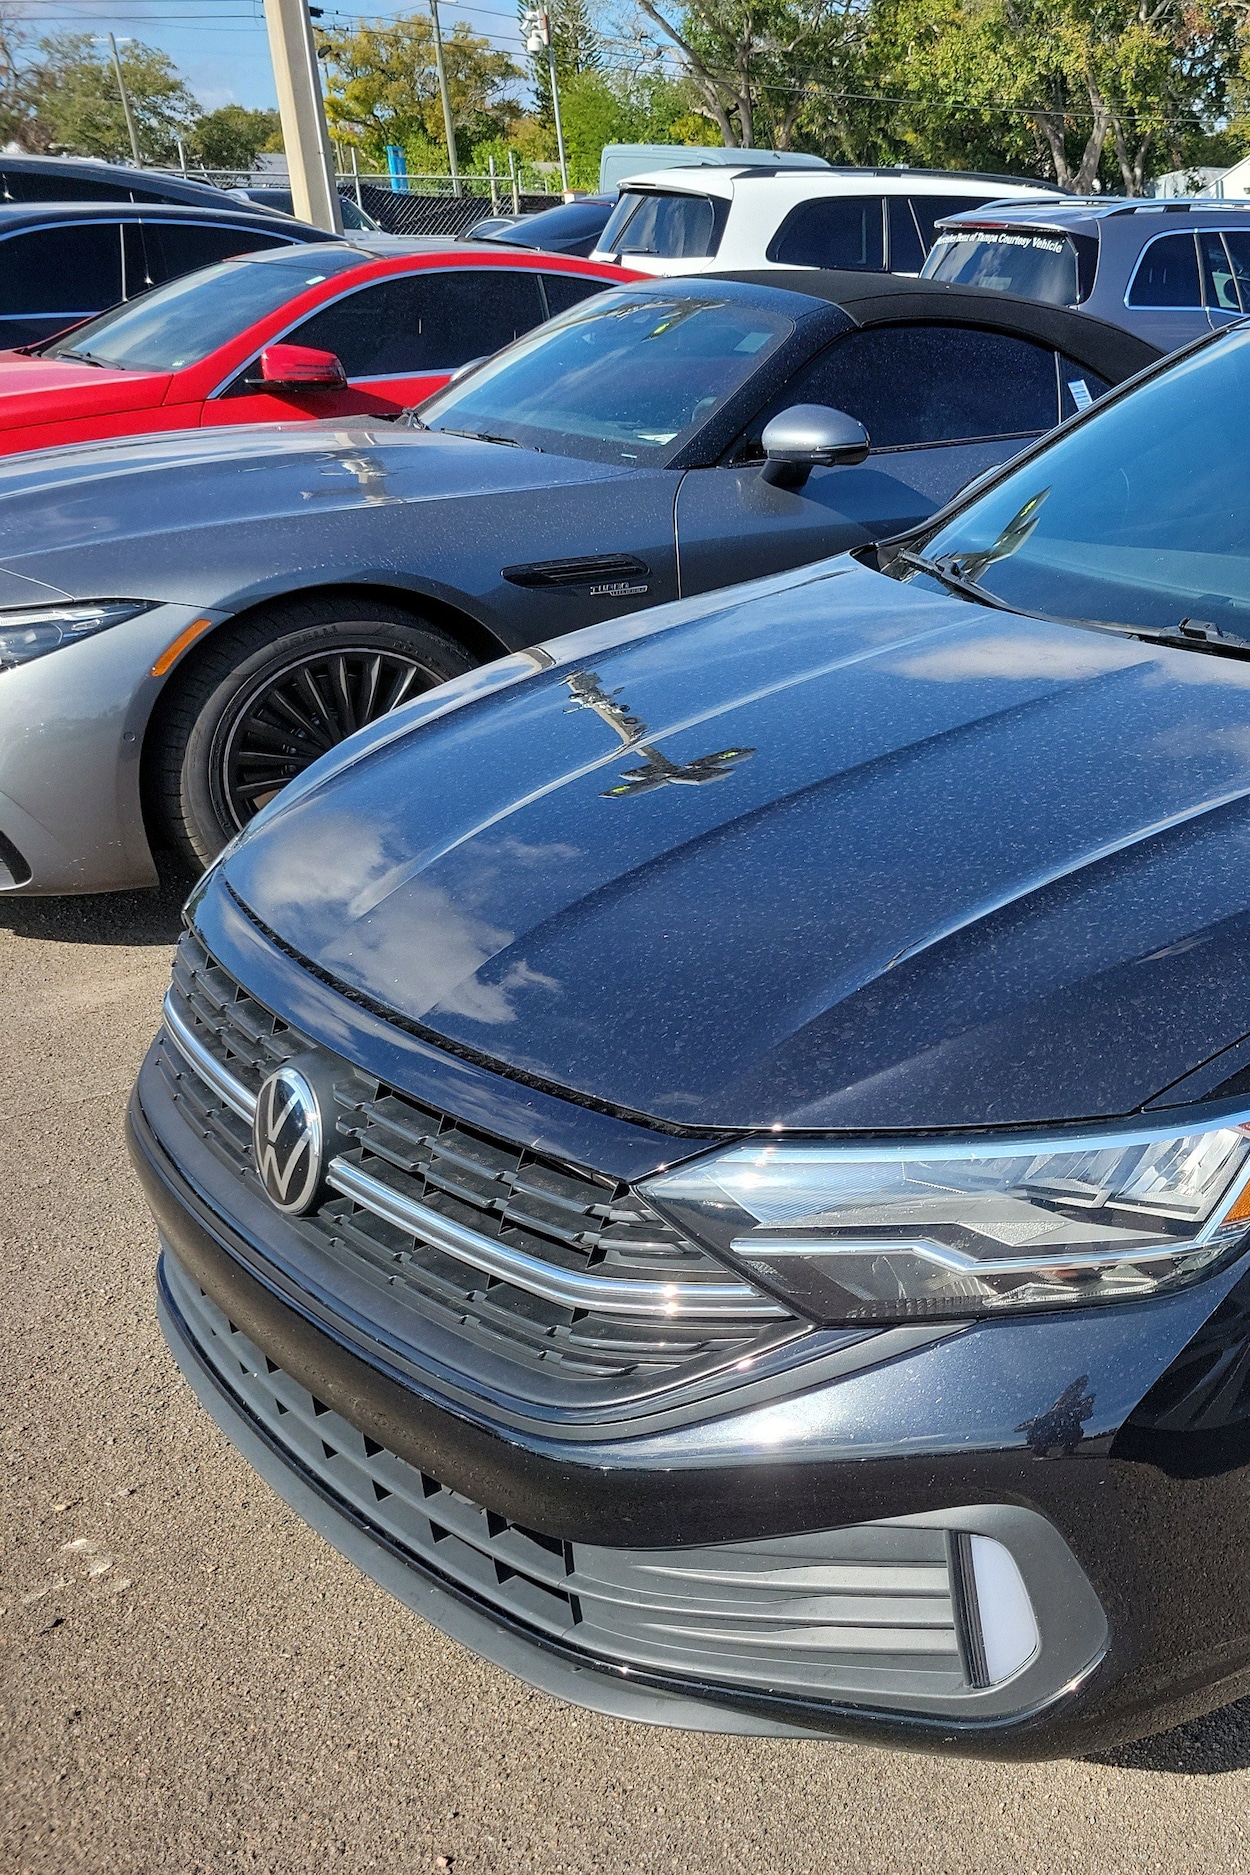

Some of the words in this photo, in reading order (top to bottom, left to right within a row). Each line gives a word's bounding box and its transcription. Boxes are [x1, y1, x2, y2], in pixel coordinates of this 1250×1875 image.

[978, 232, 998, 245] Tampa
[998, 233, 1032, 249] Courtesy
[1032, 236, 1063, 253] Vehicle
